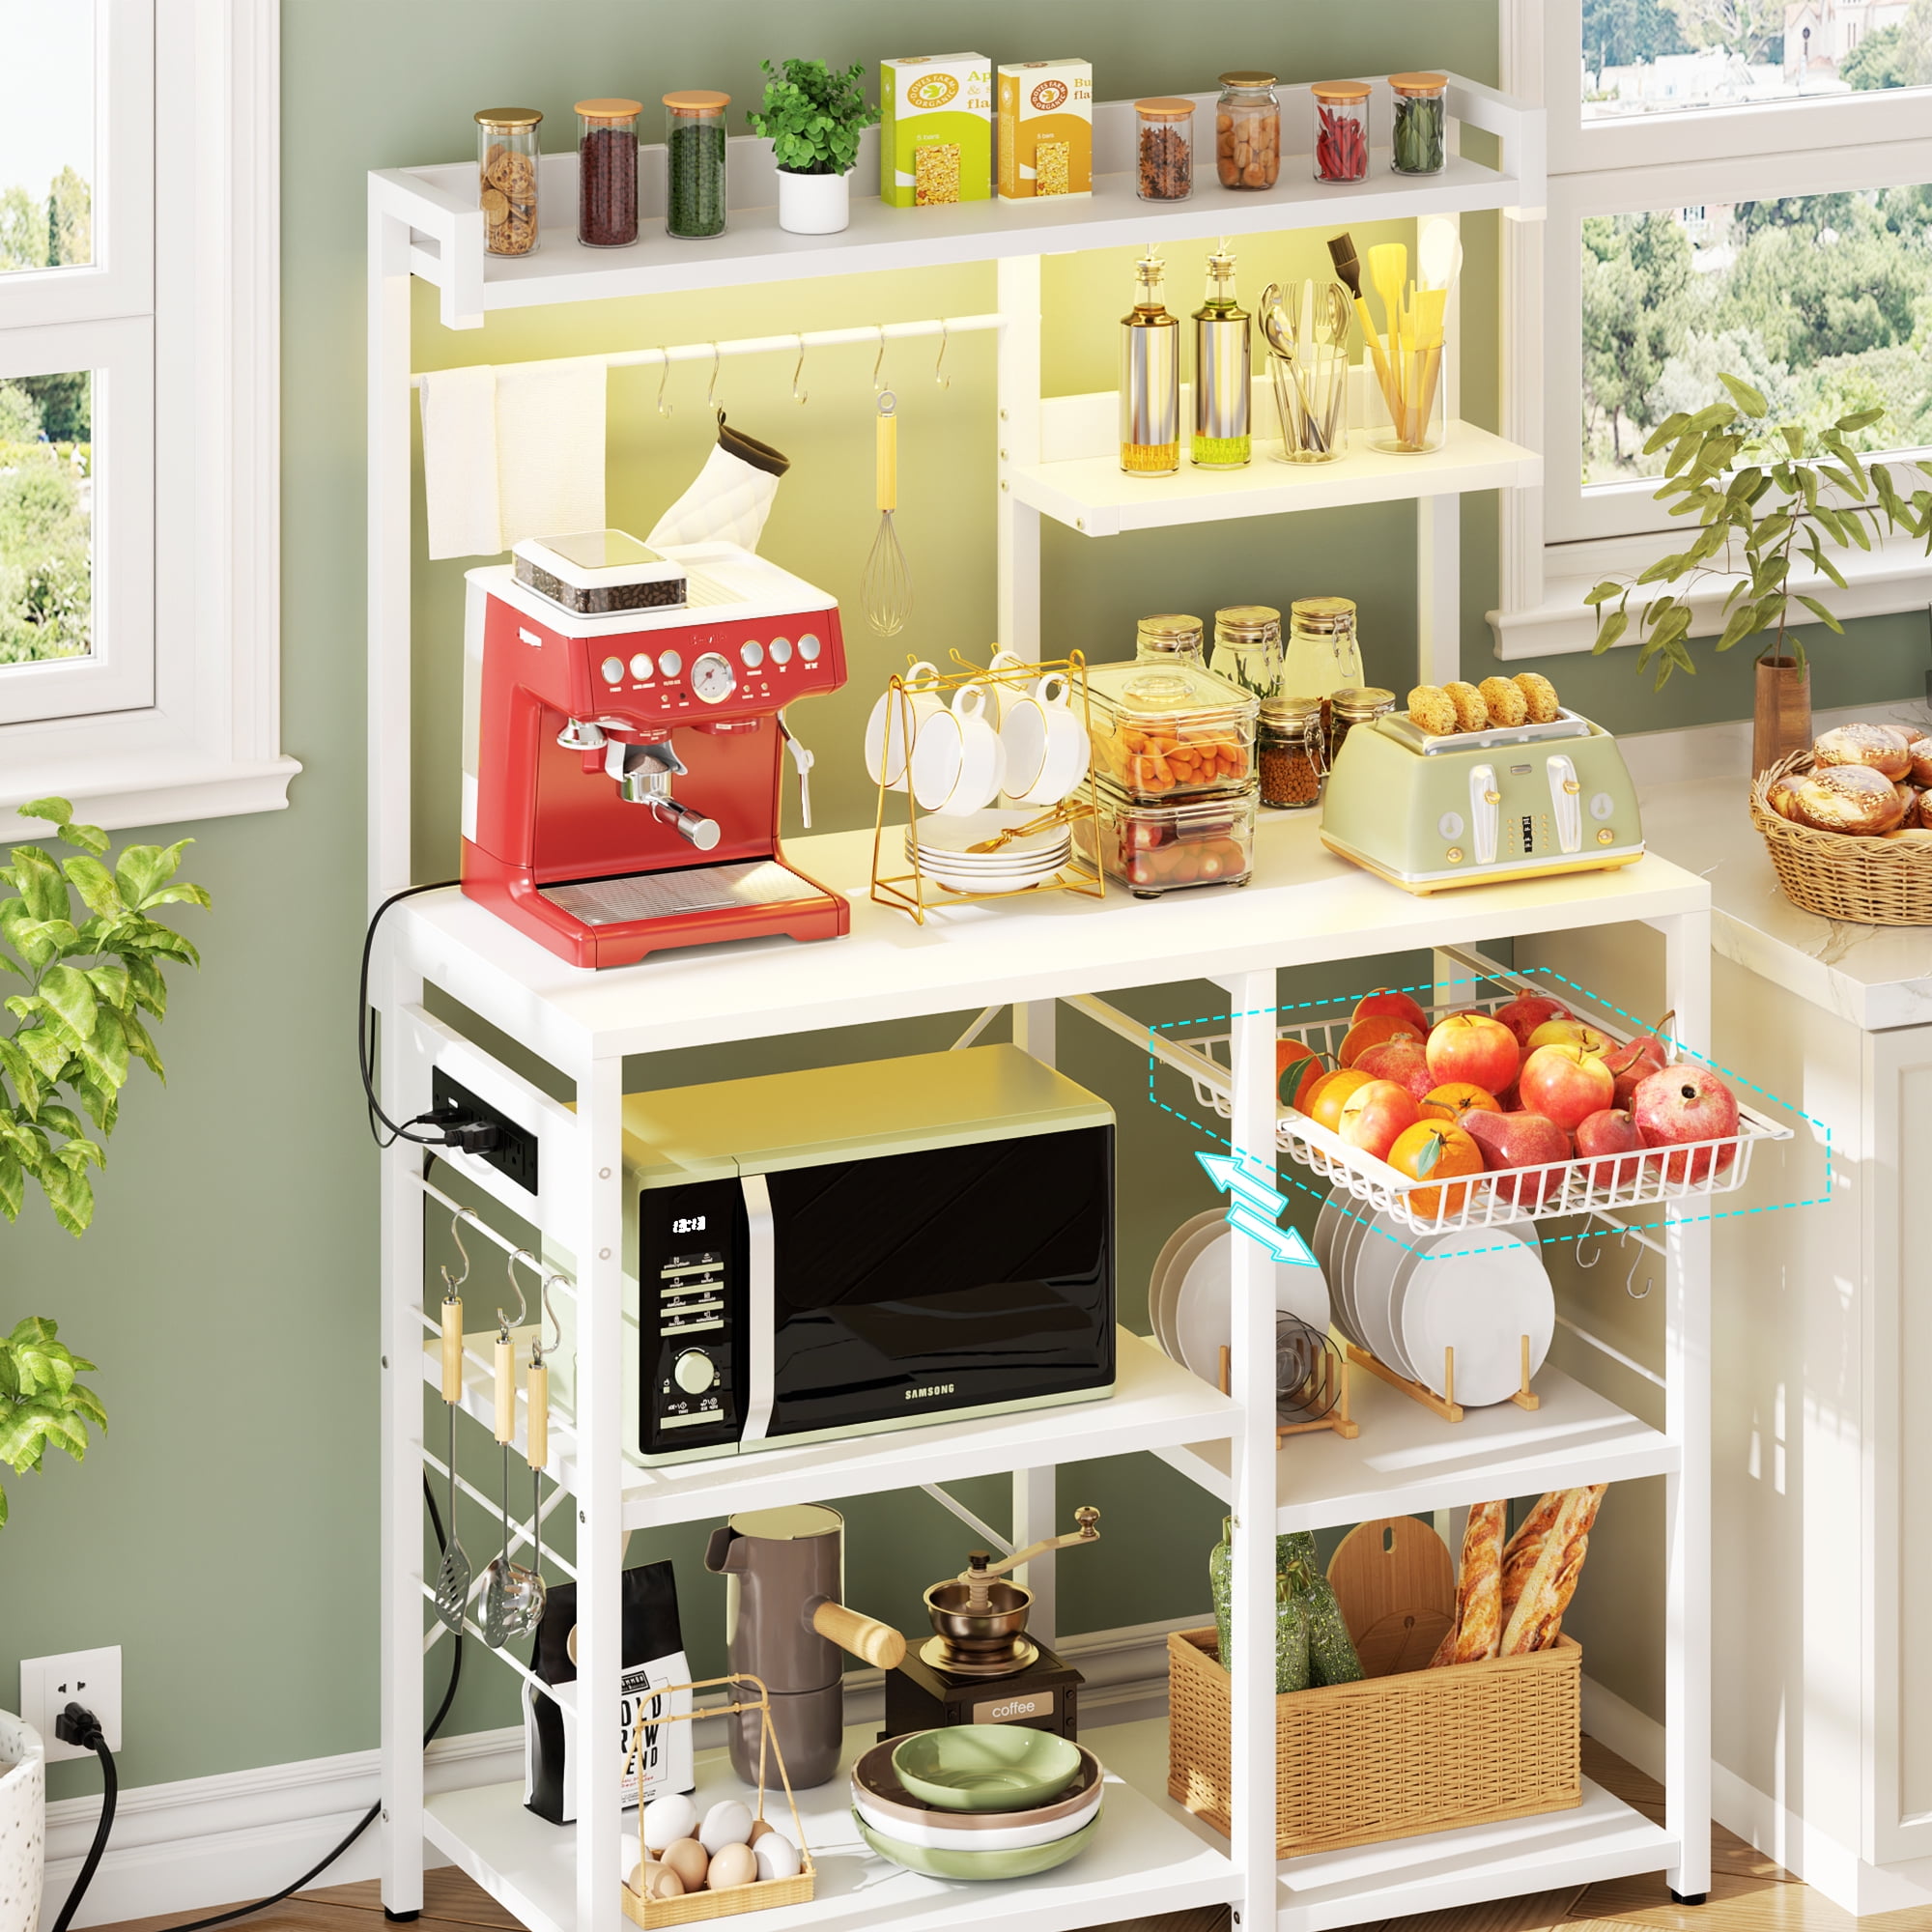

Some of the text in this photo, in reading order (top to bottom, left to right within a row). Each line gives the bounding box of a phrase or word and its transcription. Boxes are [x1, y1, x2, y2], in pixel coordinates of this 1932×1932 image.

[910, 74, 956, 99] DOVES FARM
[1074, 90, 1091, 100] fla
[915, 88, 956, 108] ORGANIC
[967, 99, 991, 109] fla
[1036, 94, 1066, 110] ORGANIC
[992, 1701, 1036, 1719] coffee
